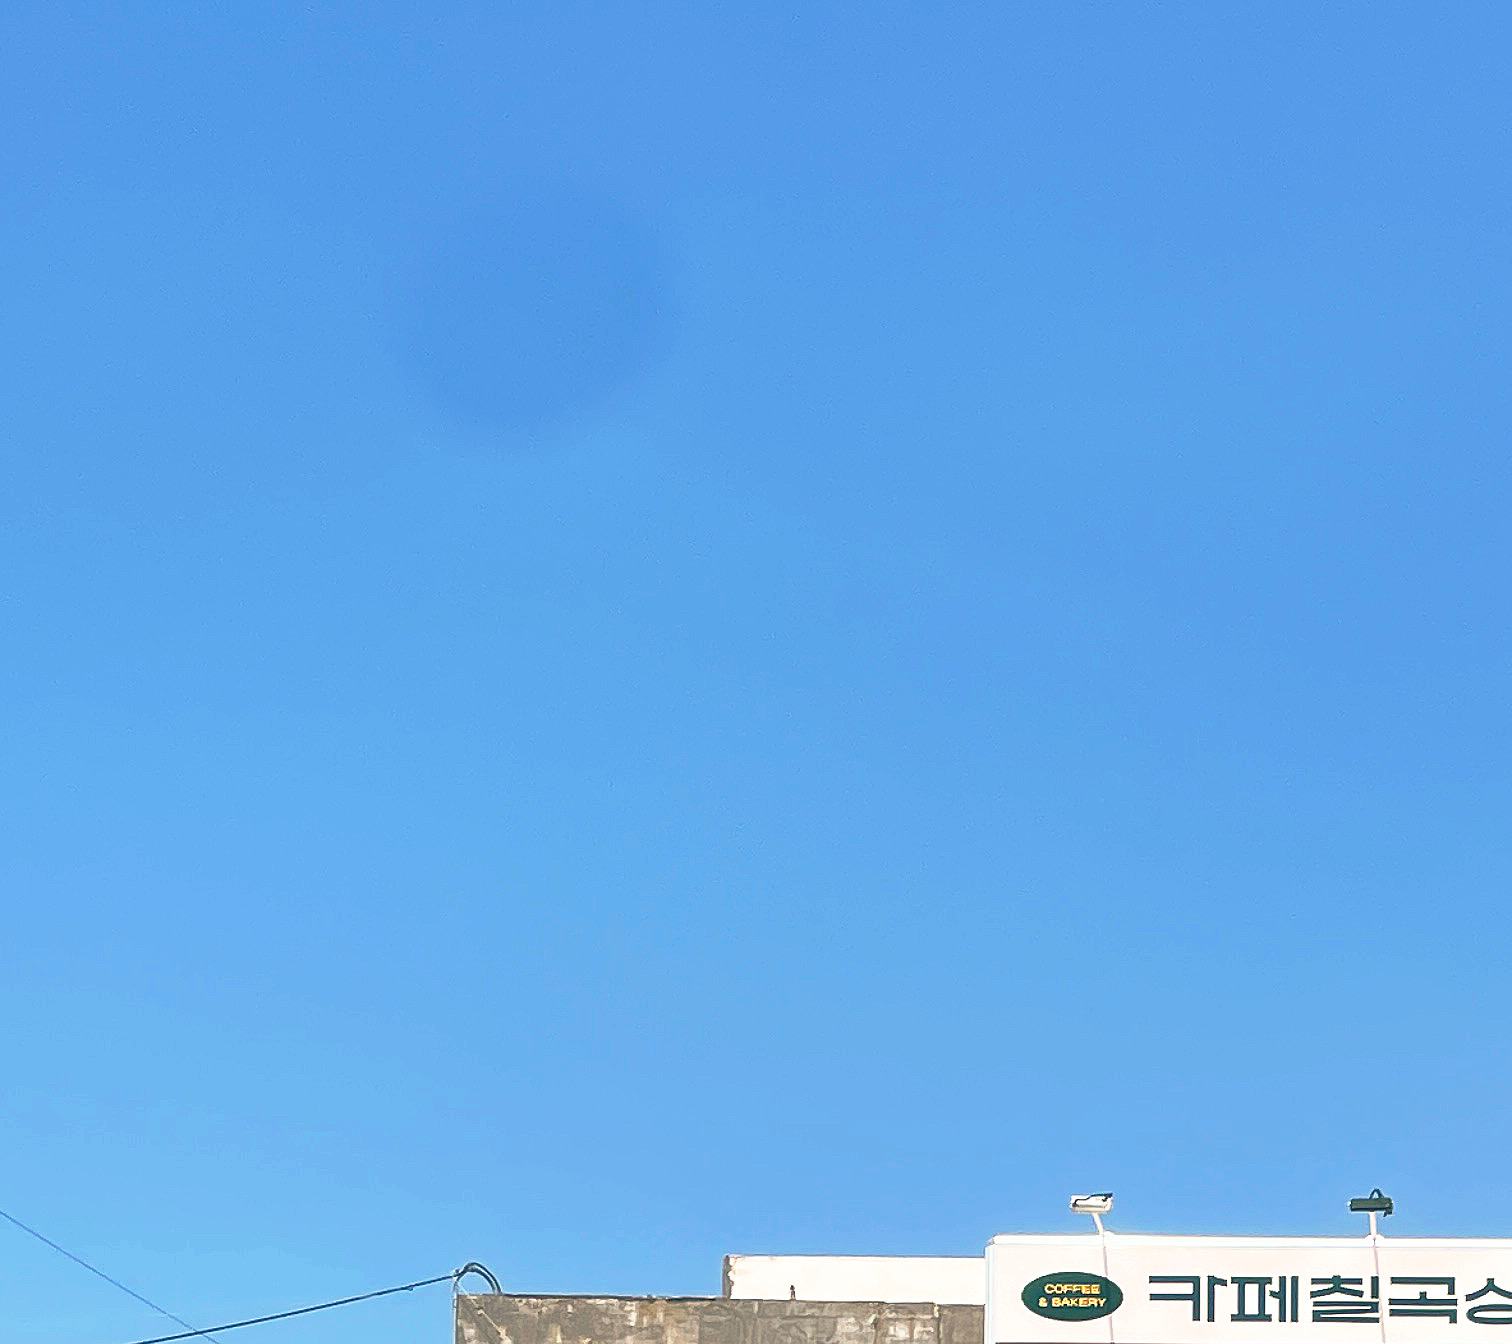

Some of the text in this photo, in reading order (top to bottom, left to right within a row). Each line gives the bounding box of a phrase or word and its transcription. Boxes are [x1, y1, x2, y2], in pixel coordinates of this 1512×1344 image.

[1044, 1283, 1100, 1295] COFFEE
[1038, 1297, 1107, 1308] & BAKERY
